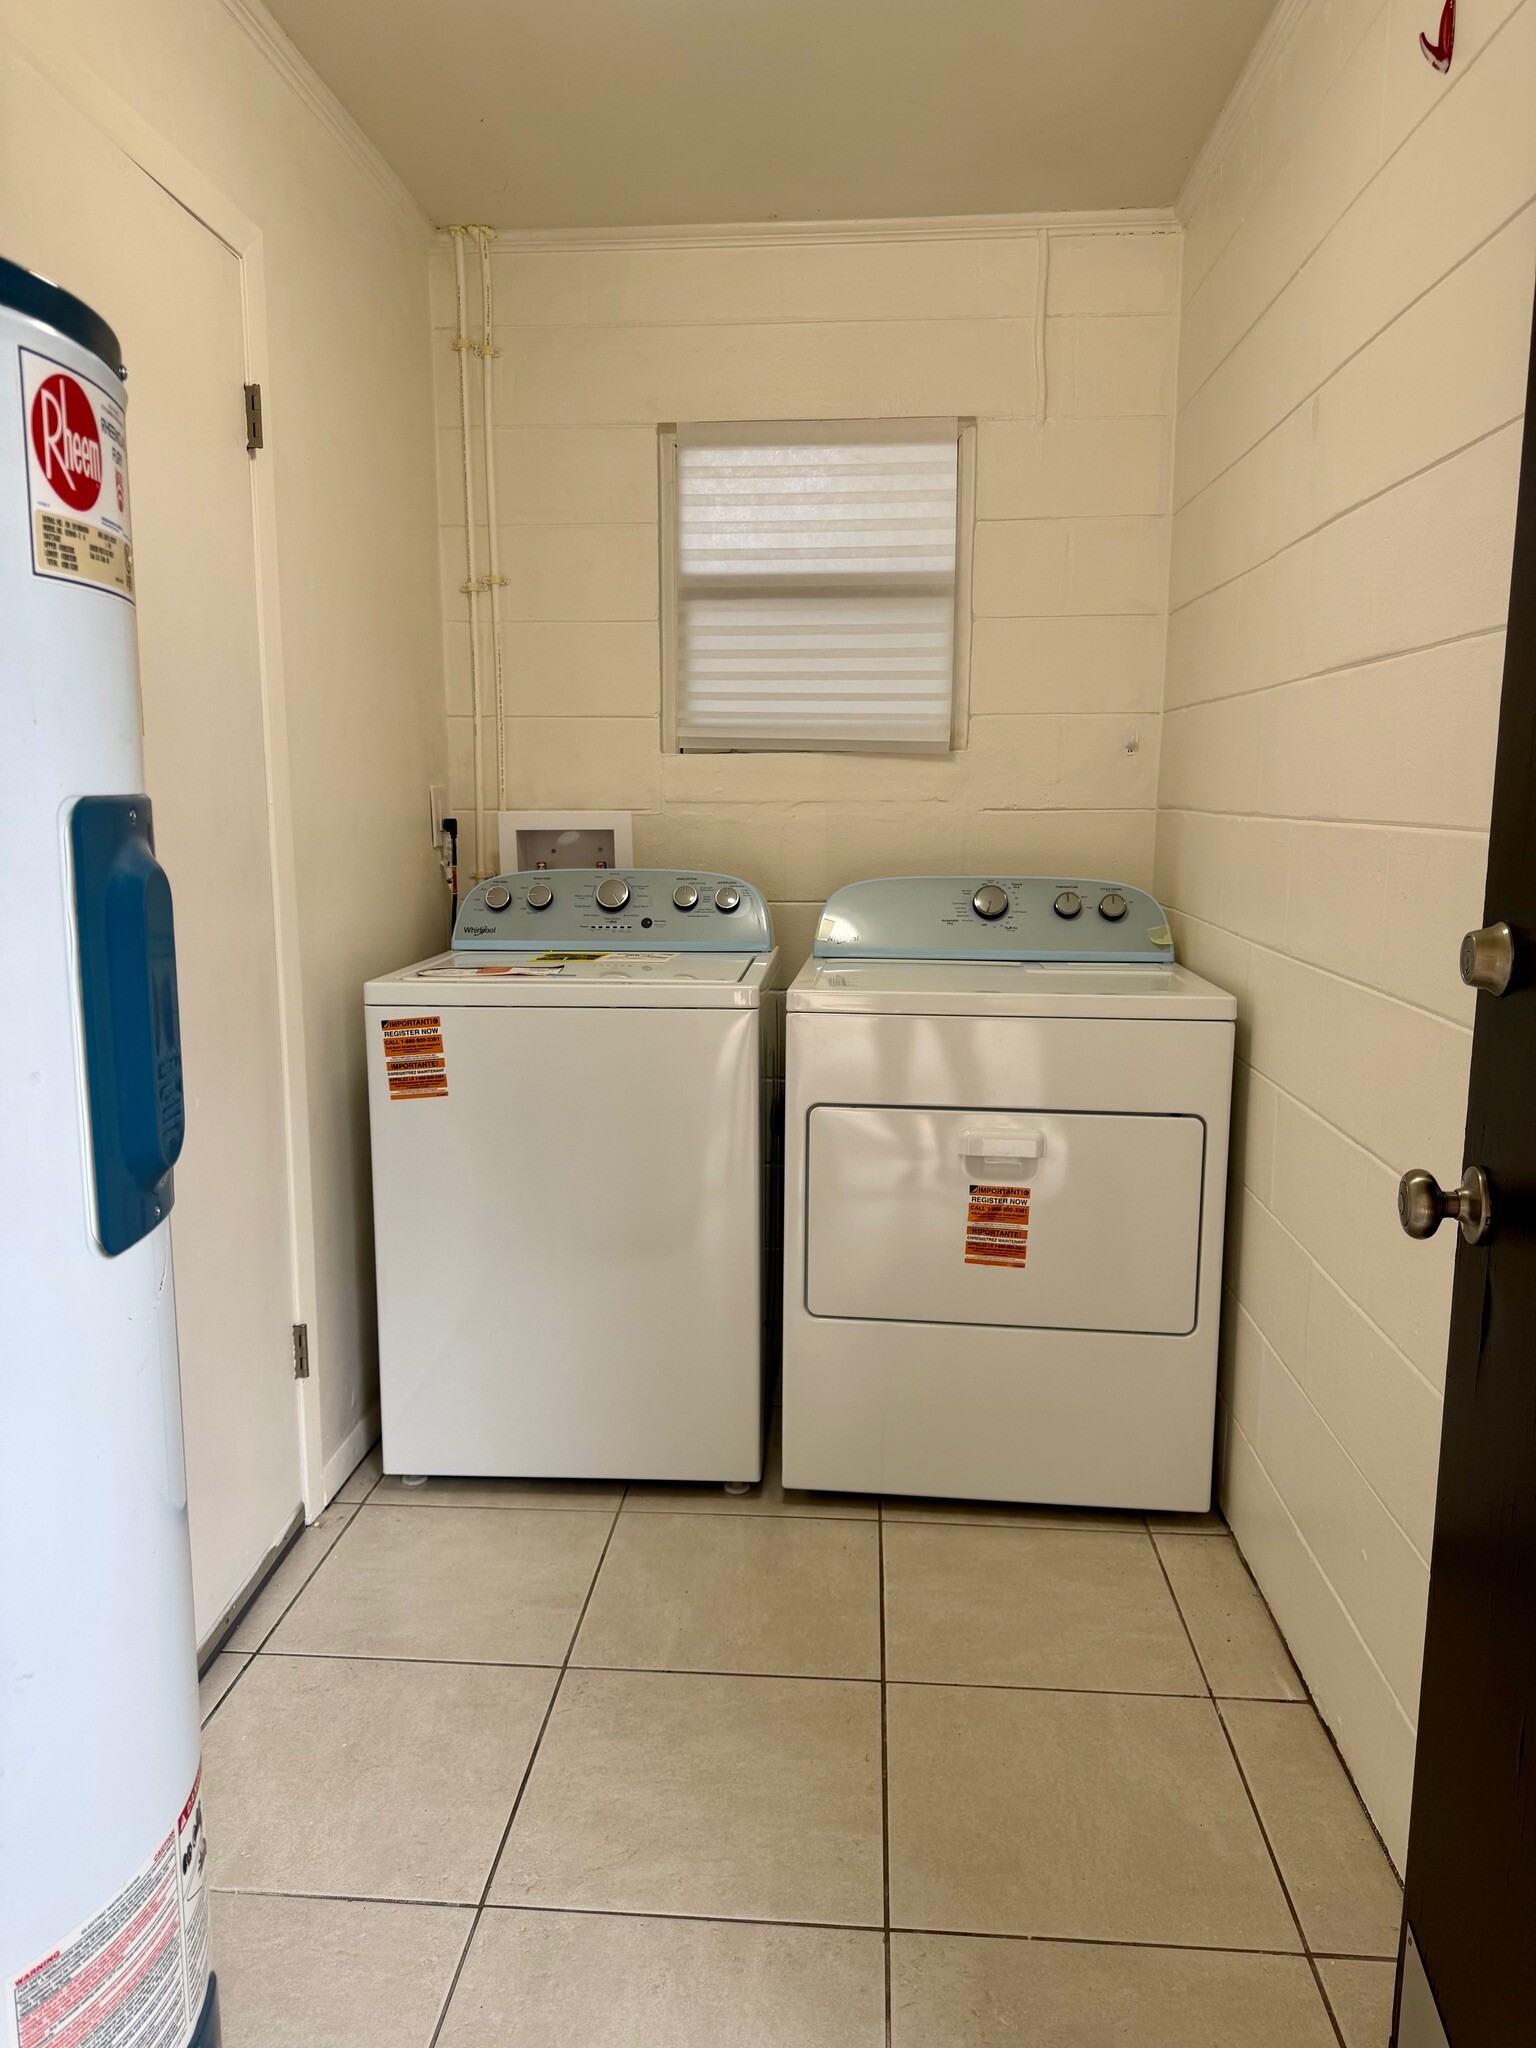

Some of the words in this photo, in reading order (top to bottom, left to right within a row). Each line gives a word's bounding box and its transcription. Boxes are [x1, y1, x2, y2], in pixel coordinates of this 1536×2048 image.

[41, 378, 101, 491] Rheem
[463, 926, 497, 937] Whirlpool
[389, 1018, 433, 1028] IMPORTANT!
[384, 1029, 420, 1038] REGISTER
[978, 1187, 1023, 1196] IMPORTANT!
[971, 1196, 1008, 1204] REGISTER
[1009, 1198, 1028, 1206] NOW
[153, 1829, 175, 1862] CAUTION
[15, 1950, 61, 1987] WARNING
